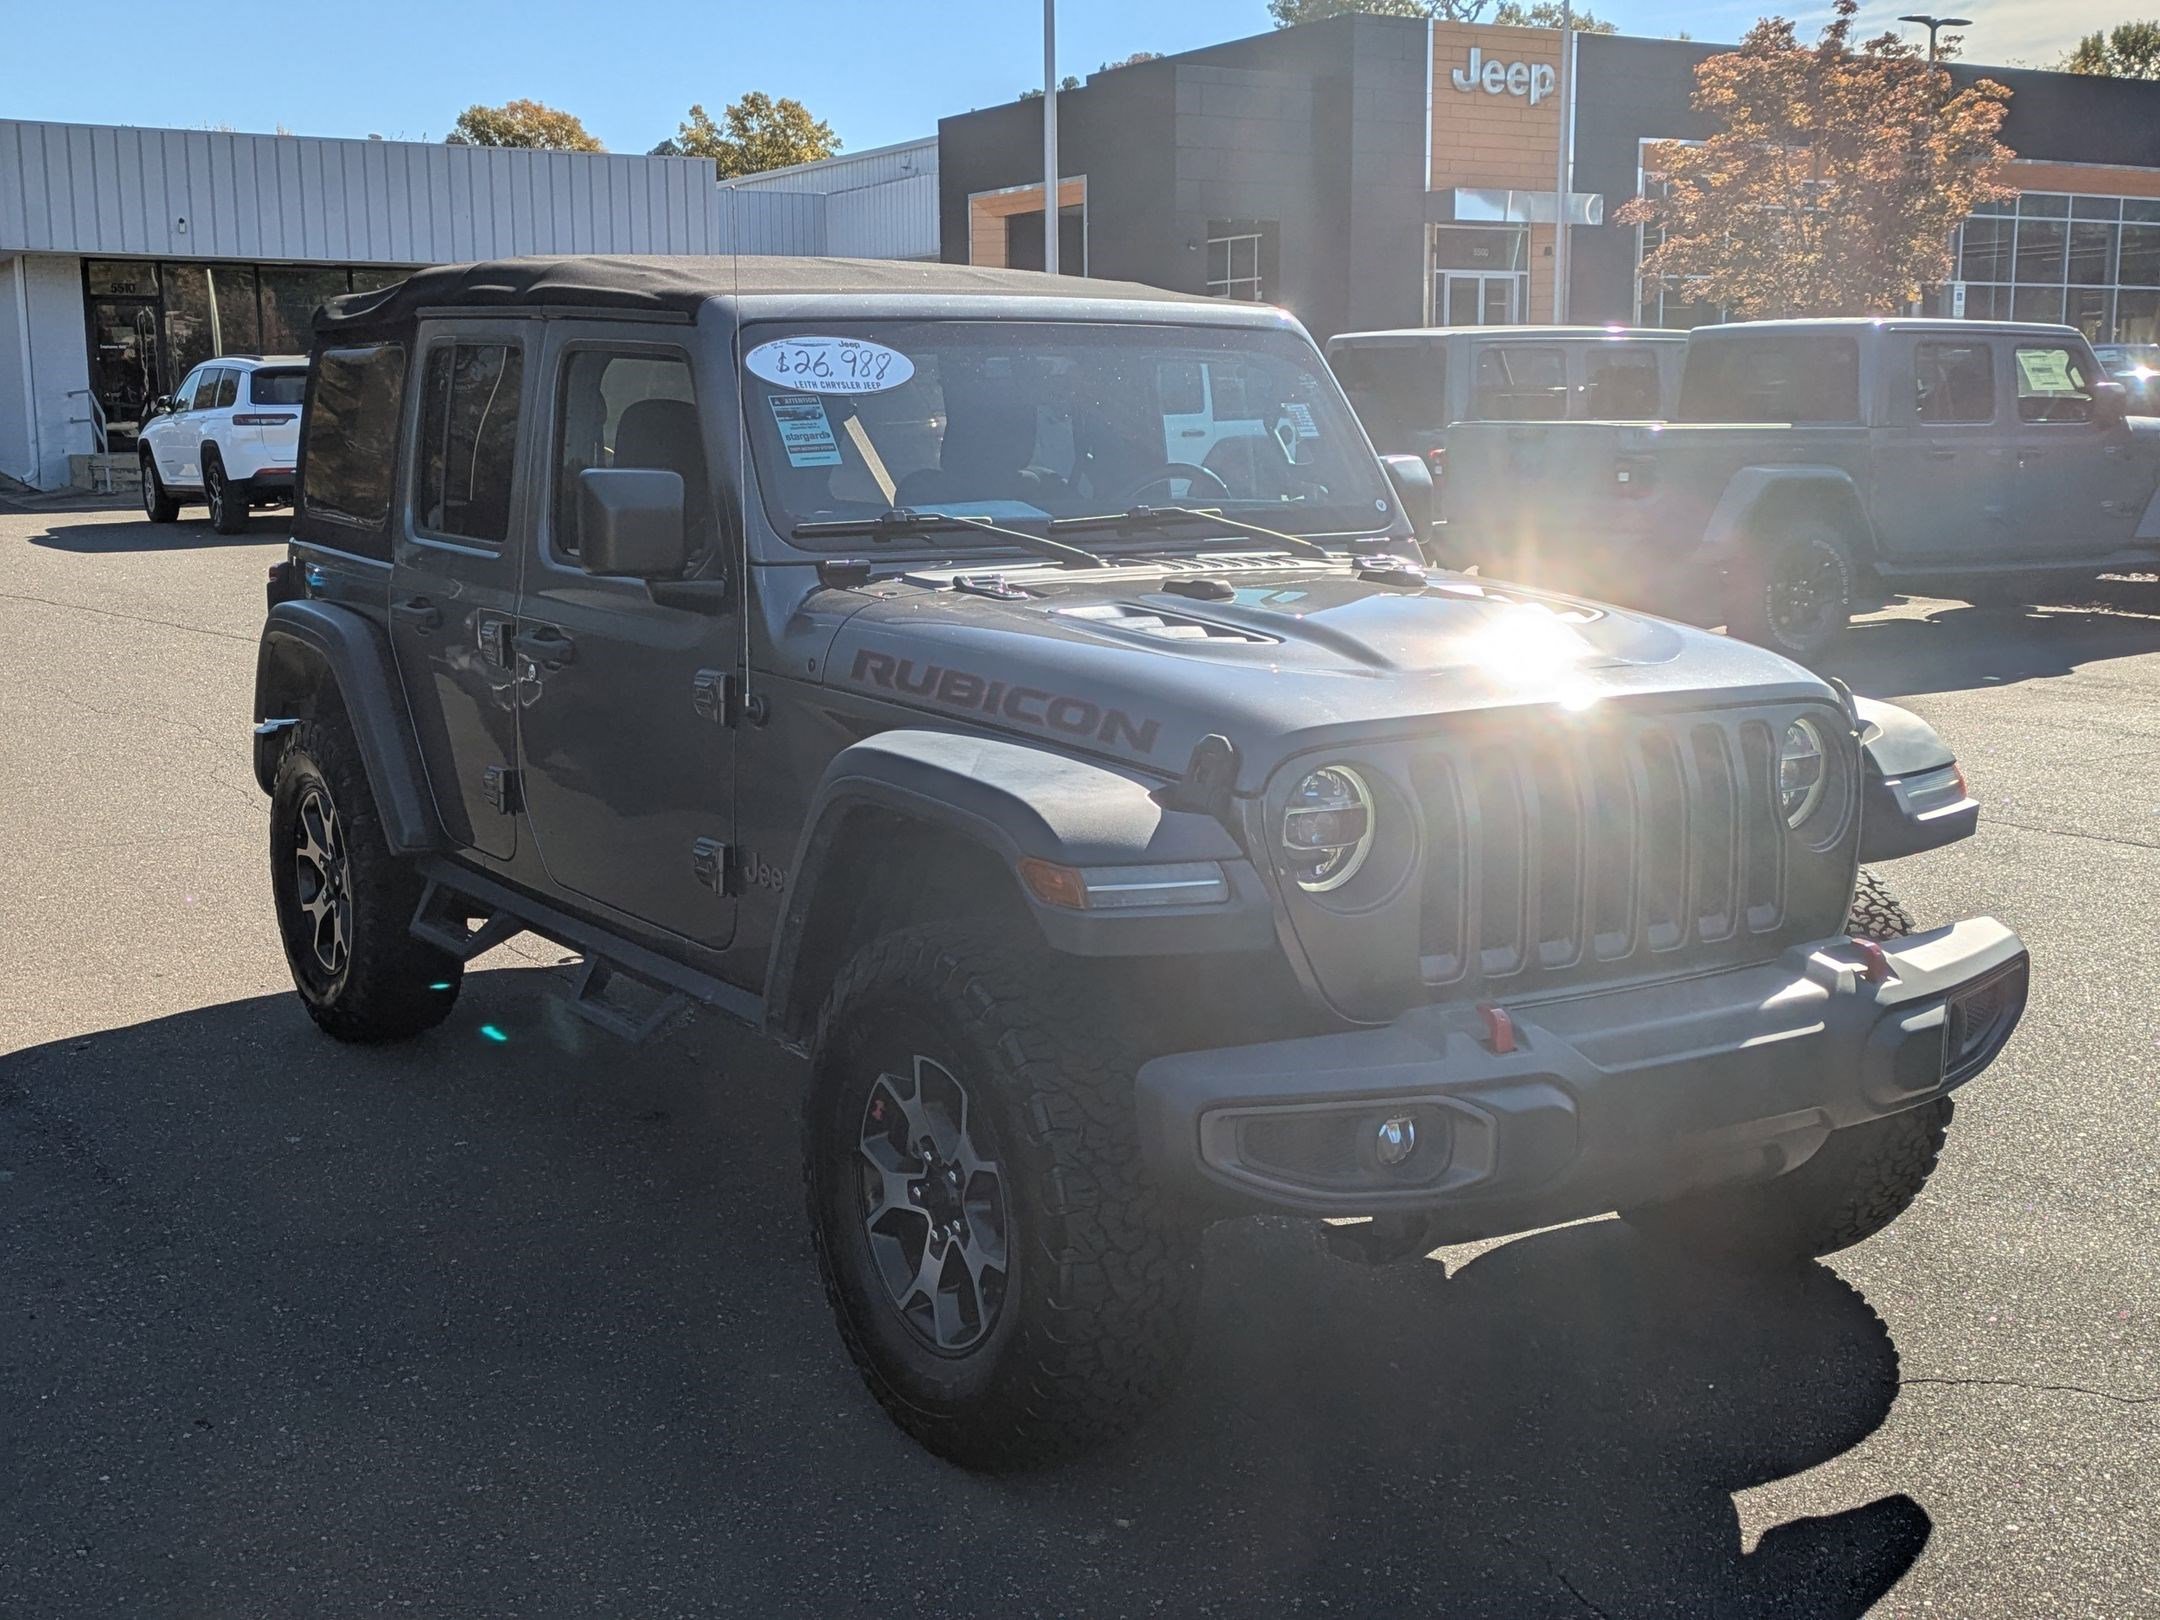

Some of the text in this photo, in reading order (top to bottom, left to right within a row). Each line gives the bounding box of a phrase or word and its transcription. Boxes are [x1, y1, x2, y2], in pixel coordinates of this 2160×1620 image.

[1452, 47, 1556, 106] Jeep
[111, 283, 136, 294] 5510
[839, 340, 861, 350] Jeep
[794, 380, 881, 390] LEITH CHRYSLER JEEP
[850, 648, 1162, 754] RUBICON
[744, 851, 788, 893] Jee
